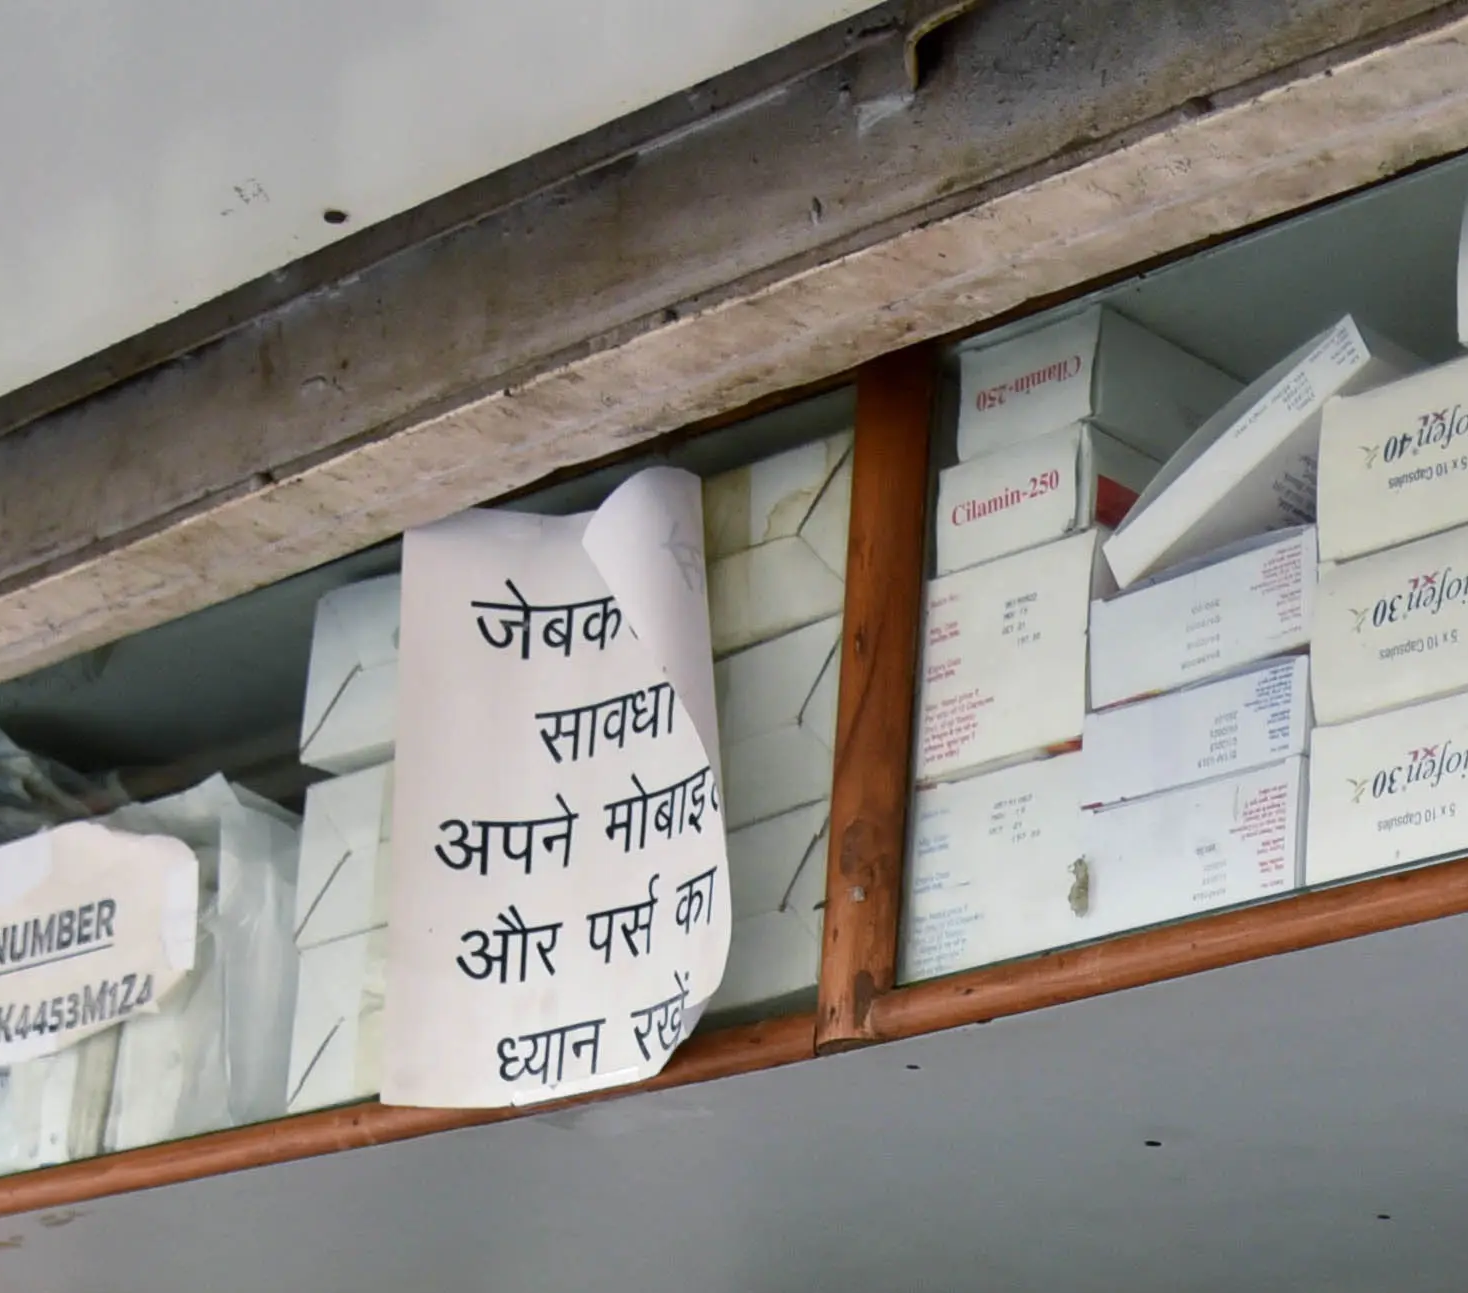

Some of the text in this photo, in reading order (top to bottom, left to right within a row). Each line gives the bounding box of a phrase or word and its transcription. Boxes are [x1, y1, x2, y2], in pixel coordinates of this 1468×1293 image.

[976, 354, 1082, 412] Cilamin-250
[951, 468, 1060, 529] Cilamin-250
[1388, 467, 1431, 489] Capsules
[471, 579, 639, 659] जेबक
[1379, 639, 1423, 661] Capsules
[535, 681, 675, 763] सावधा
[435, 794, 578, 875] अपने
[1377, 813, 1421, 834] Capsules
[456, 905, 563, 983] और
[587, 874, 659, 963] पर्स
[497, 971, 689, 1085] ध्यान रखें
